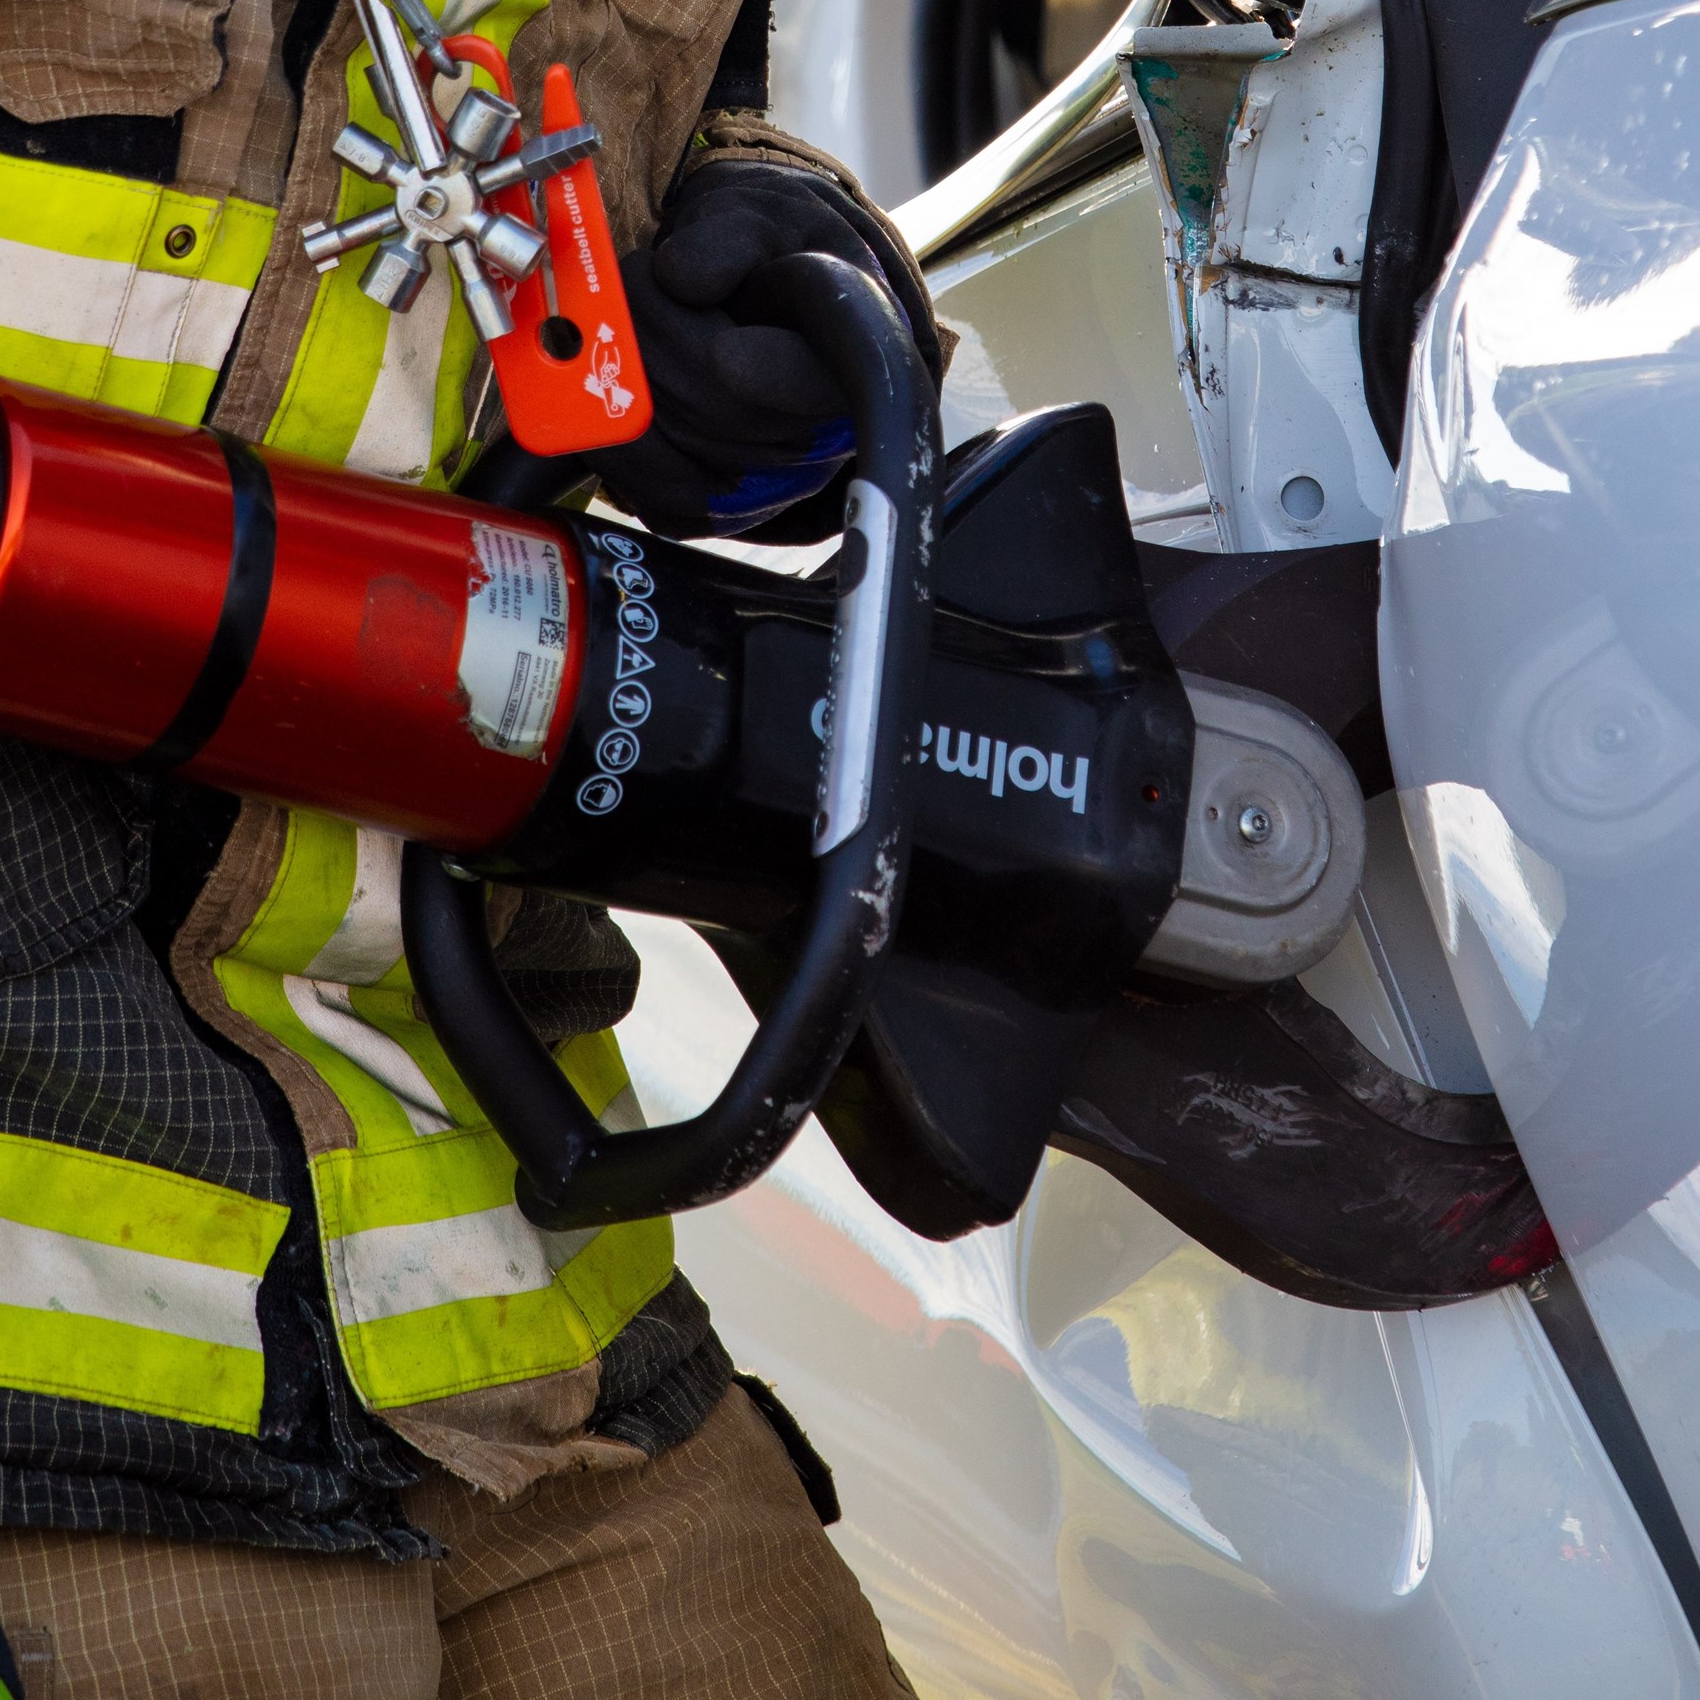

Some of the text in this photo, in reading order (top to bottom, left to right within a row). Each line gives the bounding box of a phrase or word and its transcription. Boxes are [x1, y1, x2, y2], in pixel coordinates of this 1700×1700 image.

[561, 175, 600, 292] seatbelt cutter
[524, 563, 532, 575] CU
[501, 586, 509, 619] 2016-11
[525, 577, 534, 596] 5050
[547, 561, 561, 617] holmatro
